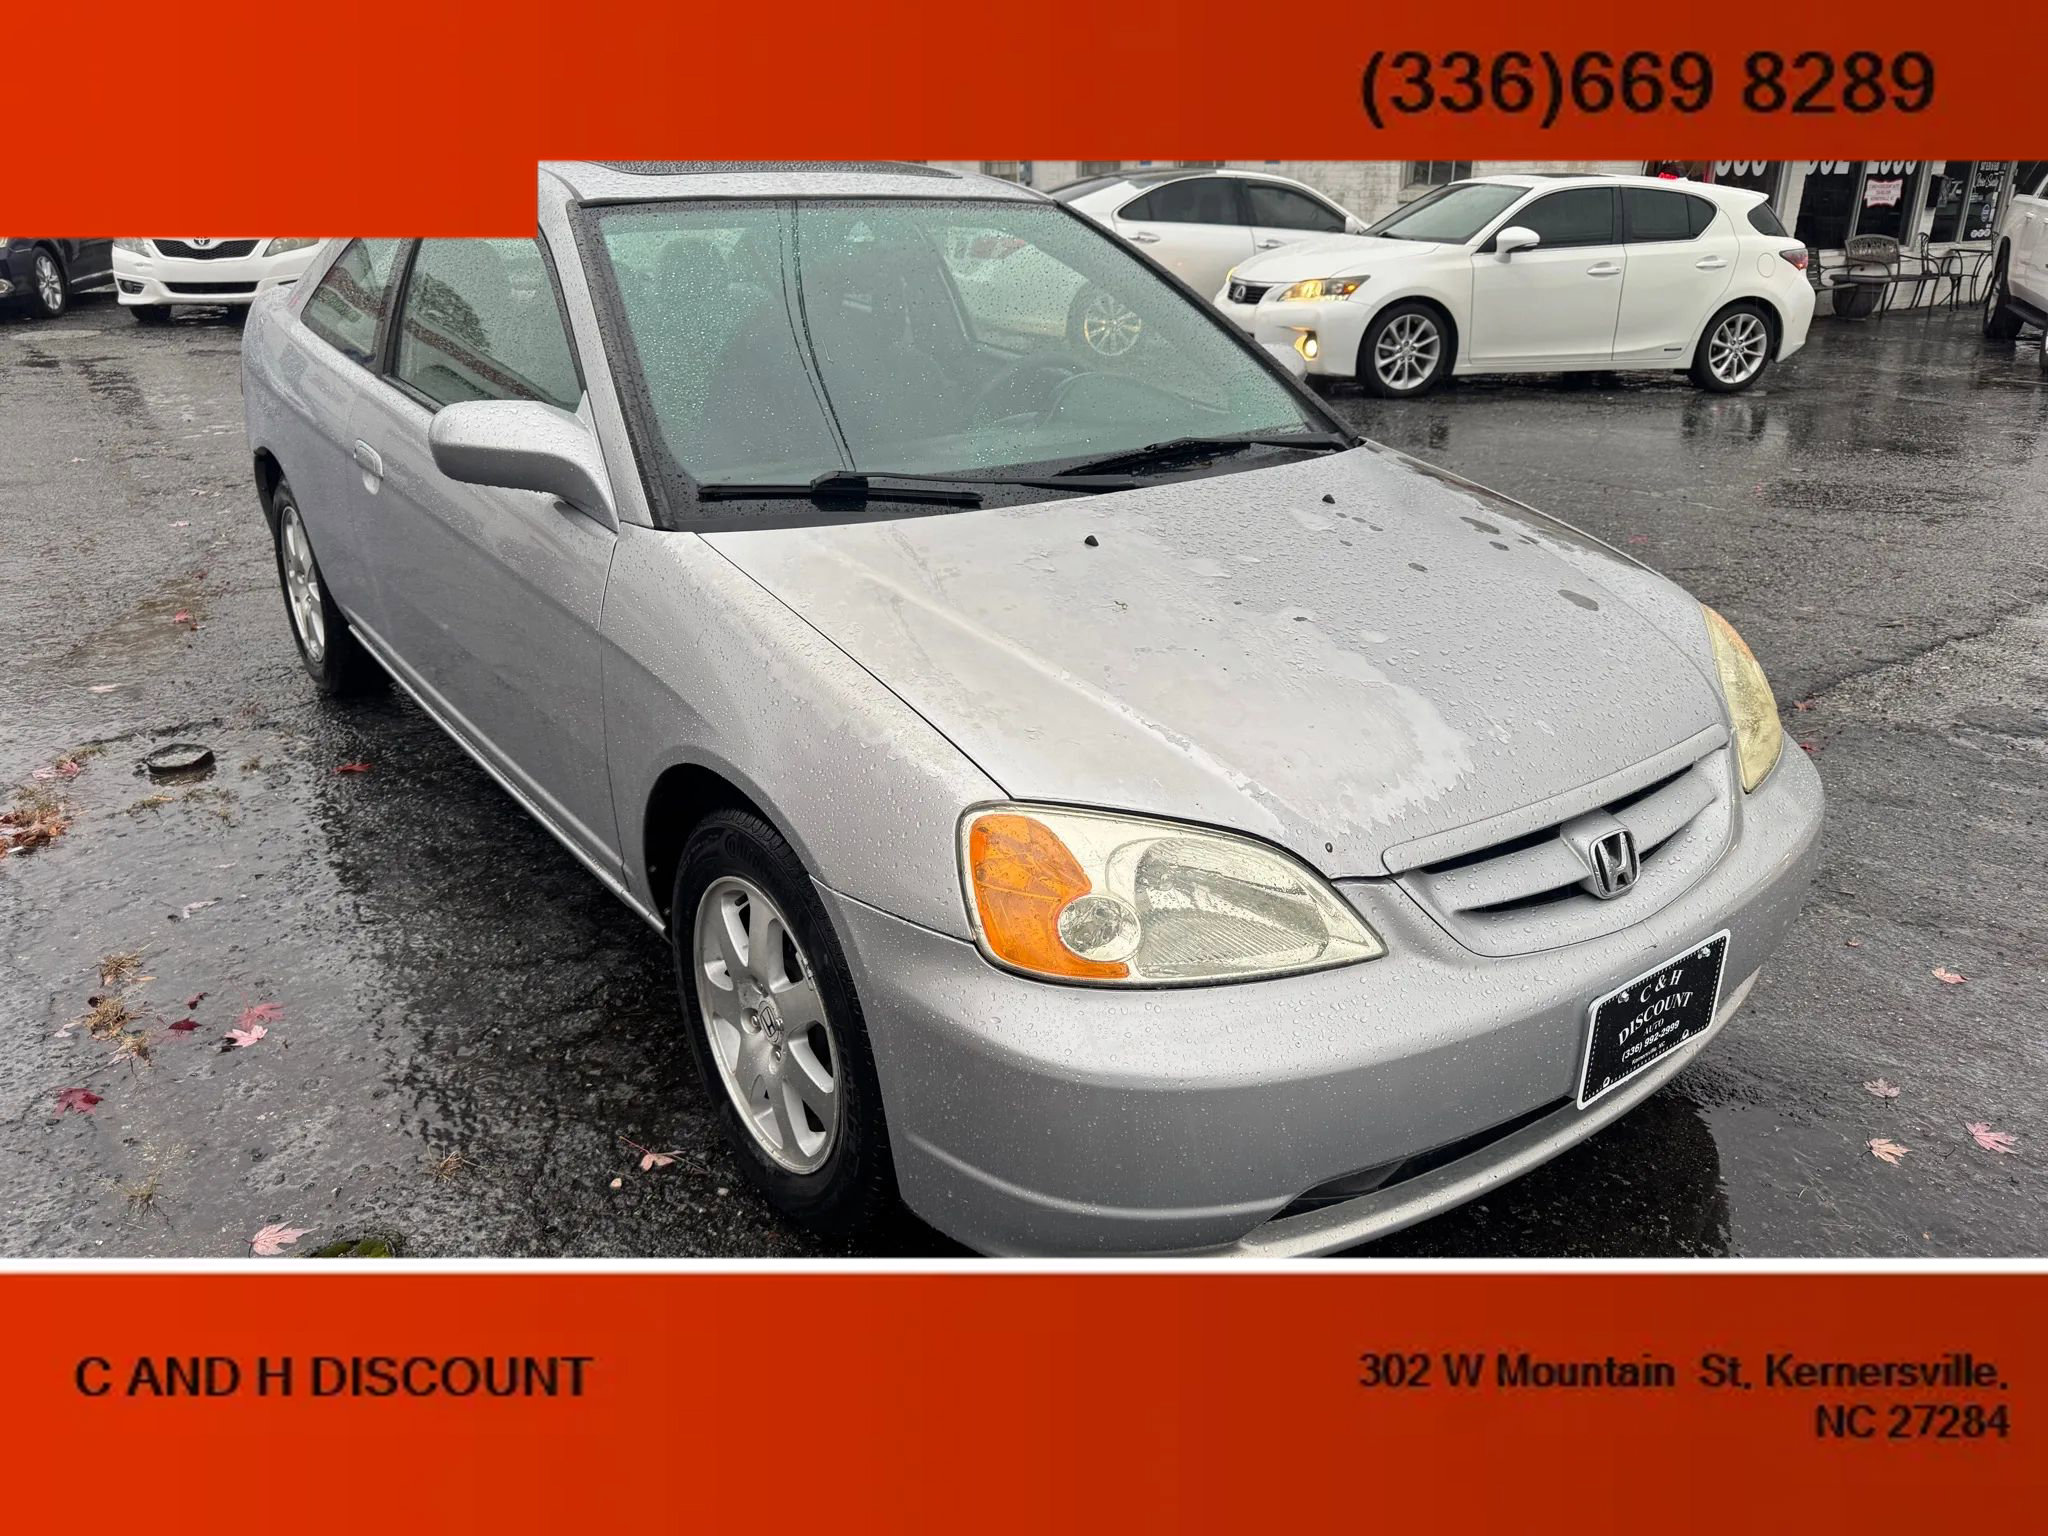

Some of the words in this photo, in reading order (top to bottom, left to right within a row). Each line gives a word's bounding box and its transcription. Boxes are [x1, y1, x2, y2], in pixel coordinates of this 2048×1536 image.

[1640, 984, 1652, 1003] C
[1655, 974, 1667, 992] &
[1670, 969, 1683, 986] H
[1618, 992, 1693, 1046] DISCOUNT
[1621, 1042, 1642, 1062] (336)
[1644, 1020, 1680, 1048] 992-2999
